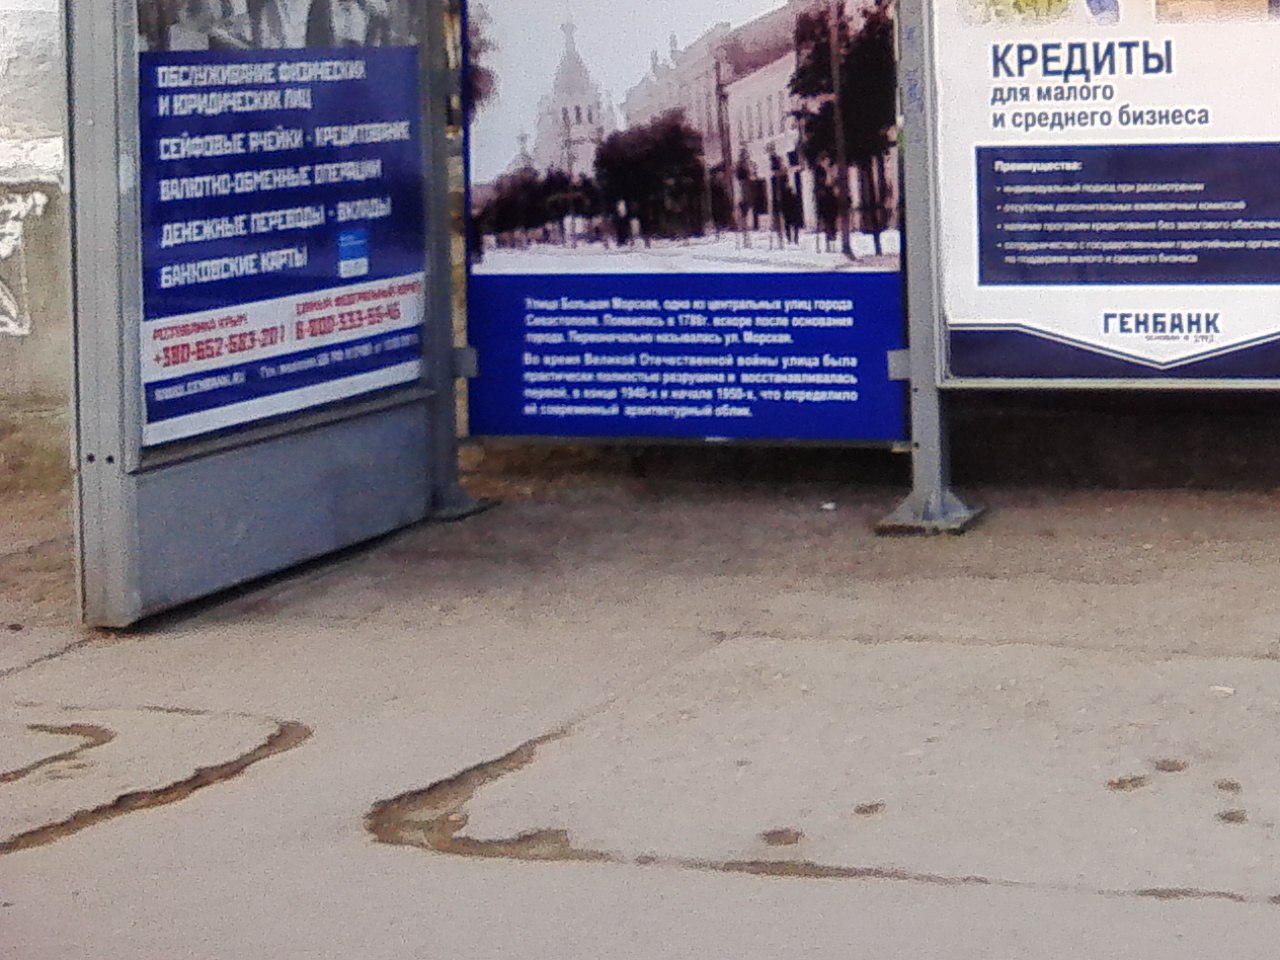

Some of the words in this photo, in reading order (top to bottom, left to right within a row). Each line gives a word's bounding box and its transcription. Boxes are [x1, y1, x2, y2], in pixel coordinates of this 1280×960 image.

[992, 40, 1172, 83] КРЕДИТЫ
[991, 87, 1030, 105] для
[1037, 84, 1114, 102] малого
[992, 112, 1005, 127] и
[1012, 110, 1112, 131] среднего
[1118, 103, 1209, 125] бизнеса
[159, 131, 247, 161] СЕЙФОВЫЕ
[249, 124, 304, 152] ЯЧЕЙКИ
[161, 214, 247, 249] ДЕНЕЖНЫЕ
[250, 204, 325, 233] ПЕРЕВОДЫ
[336, 196, 392, 222] ВКЛАДЫ
[160, 253, 259, 289] БАНКОВСКИЕ
[261, 245, 308, 273] КАРТЫ
[1104, 312, 1220, 334] ГЕНБАНК
